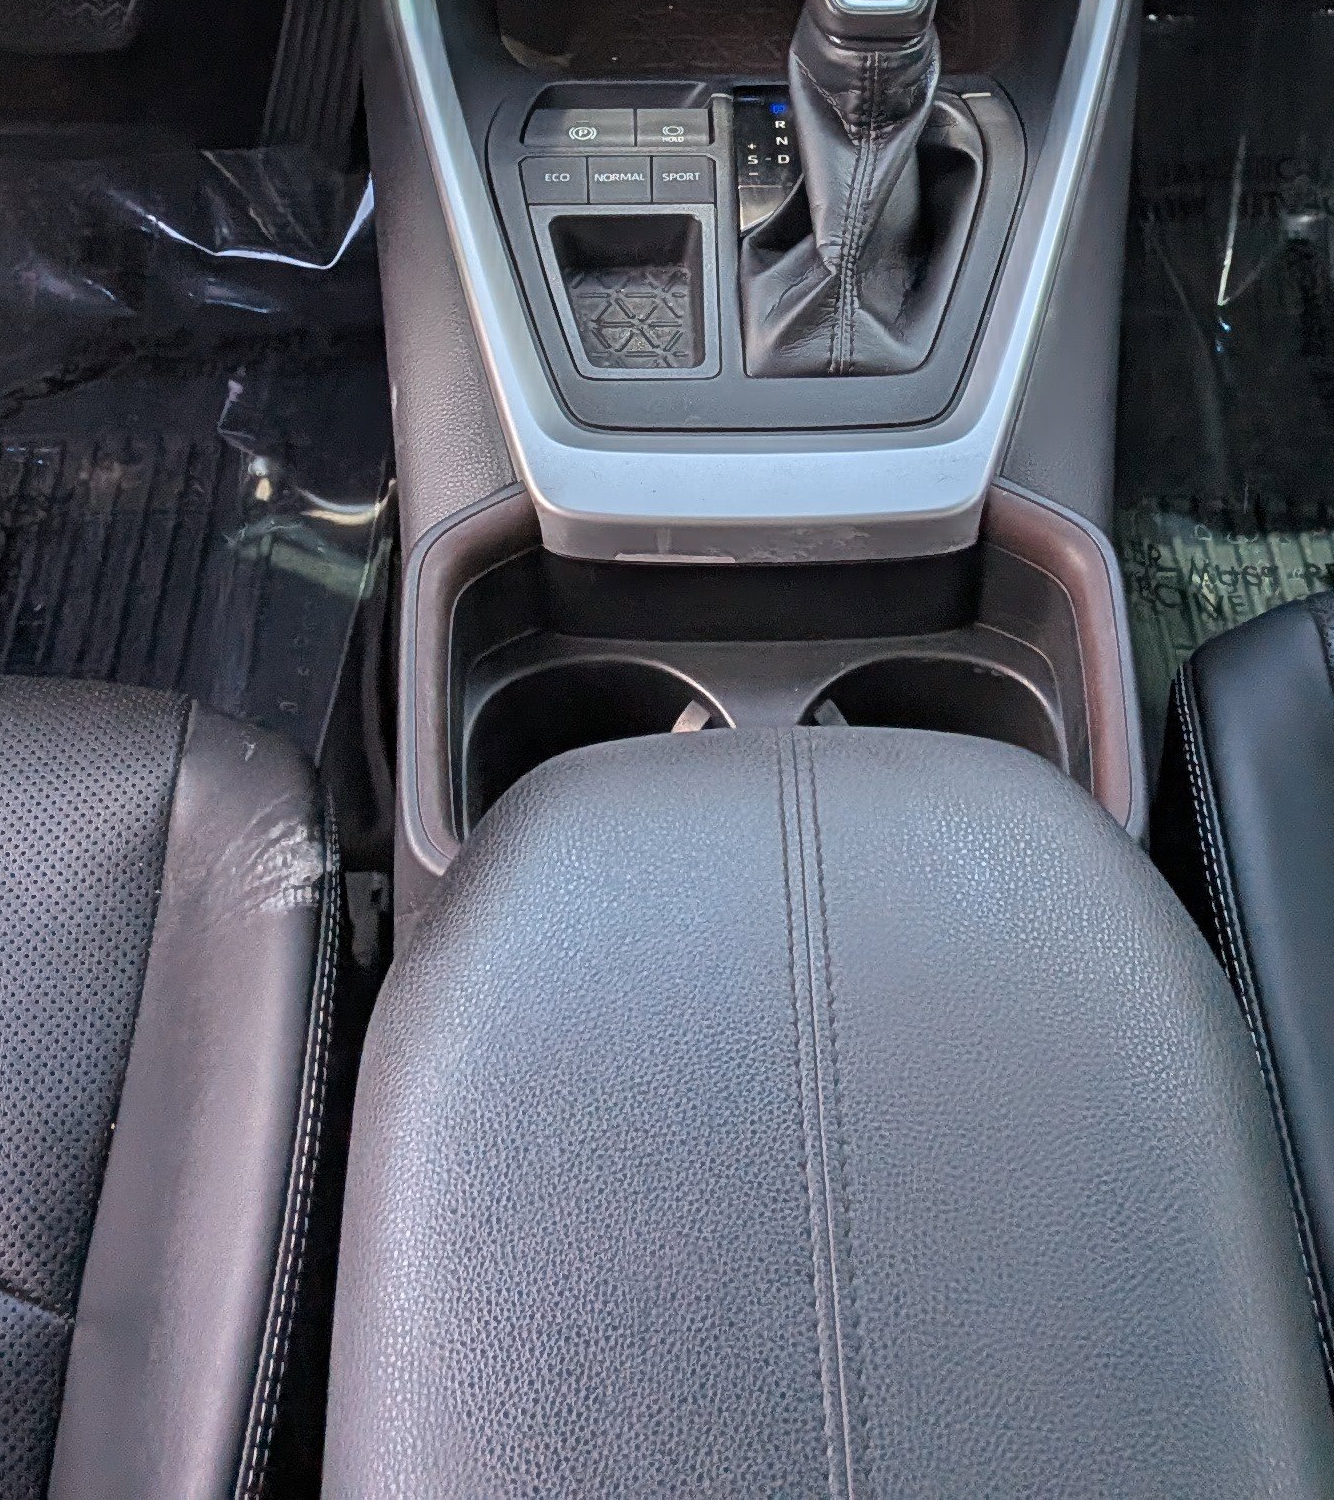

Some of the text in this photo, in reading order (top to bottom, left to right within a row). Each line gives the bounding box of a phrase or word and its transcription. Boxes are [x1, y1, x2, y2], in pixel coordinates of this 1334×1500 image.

[774, 120, 786, 129] R
[775, 136, 789, 146] N
[747, 154, 759, 165] S
[777, 154, 790, 164] D
[544, 173, 571, 183] ECO
[594, 172, 646, 183] NORMAL
[662, 172, 701, 183] SPORT
